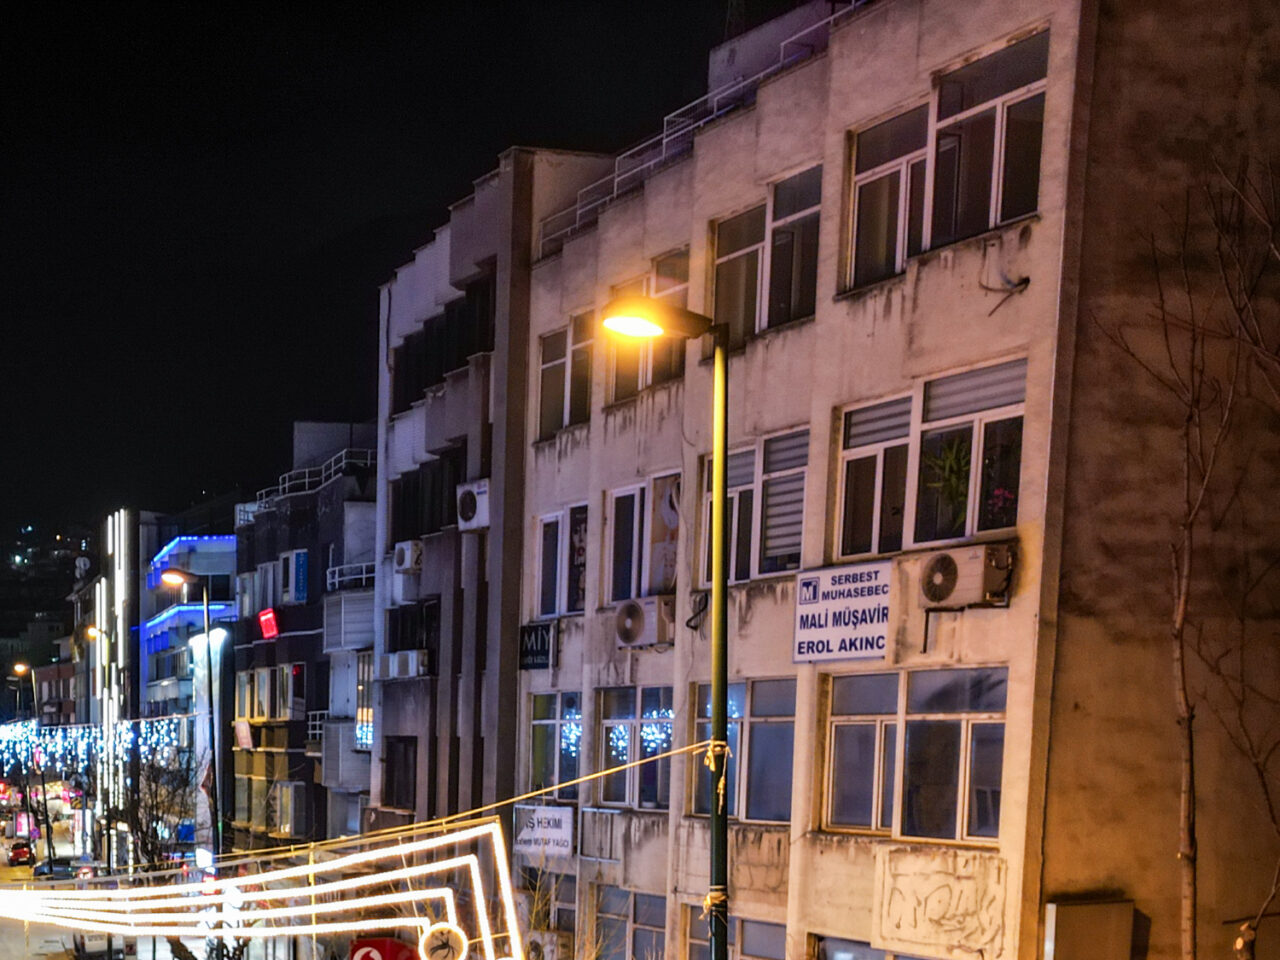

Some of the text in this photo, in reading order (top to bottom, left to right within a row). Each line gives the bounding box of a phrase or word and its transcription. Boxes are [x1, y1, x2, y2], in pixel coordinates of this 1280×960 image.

[831, 570, 880, 586] SERBEST
[799, 603, 889, 630] MALİ MÜŞAVİR
[797, 635, 886, 655] EROL AKINC
